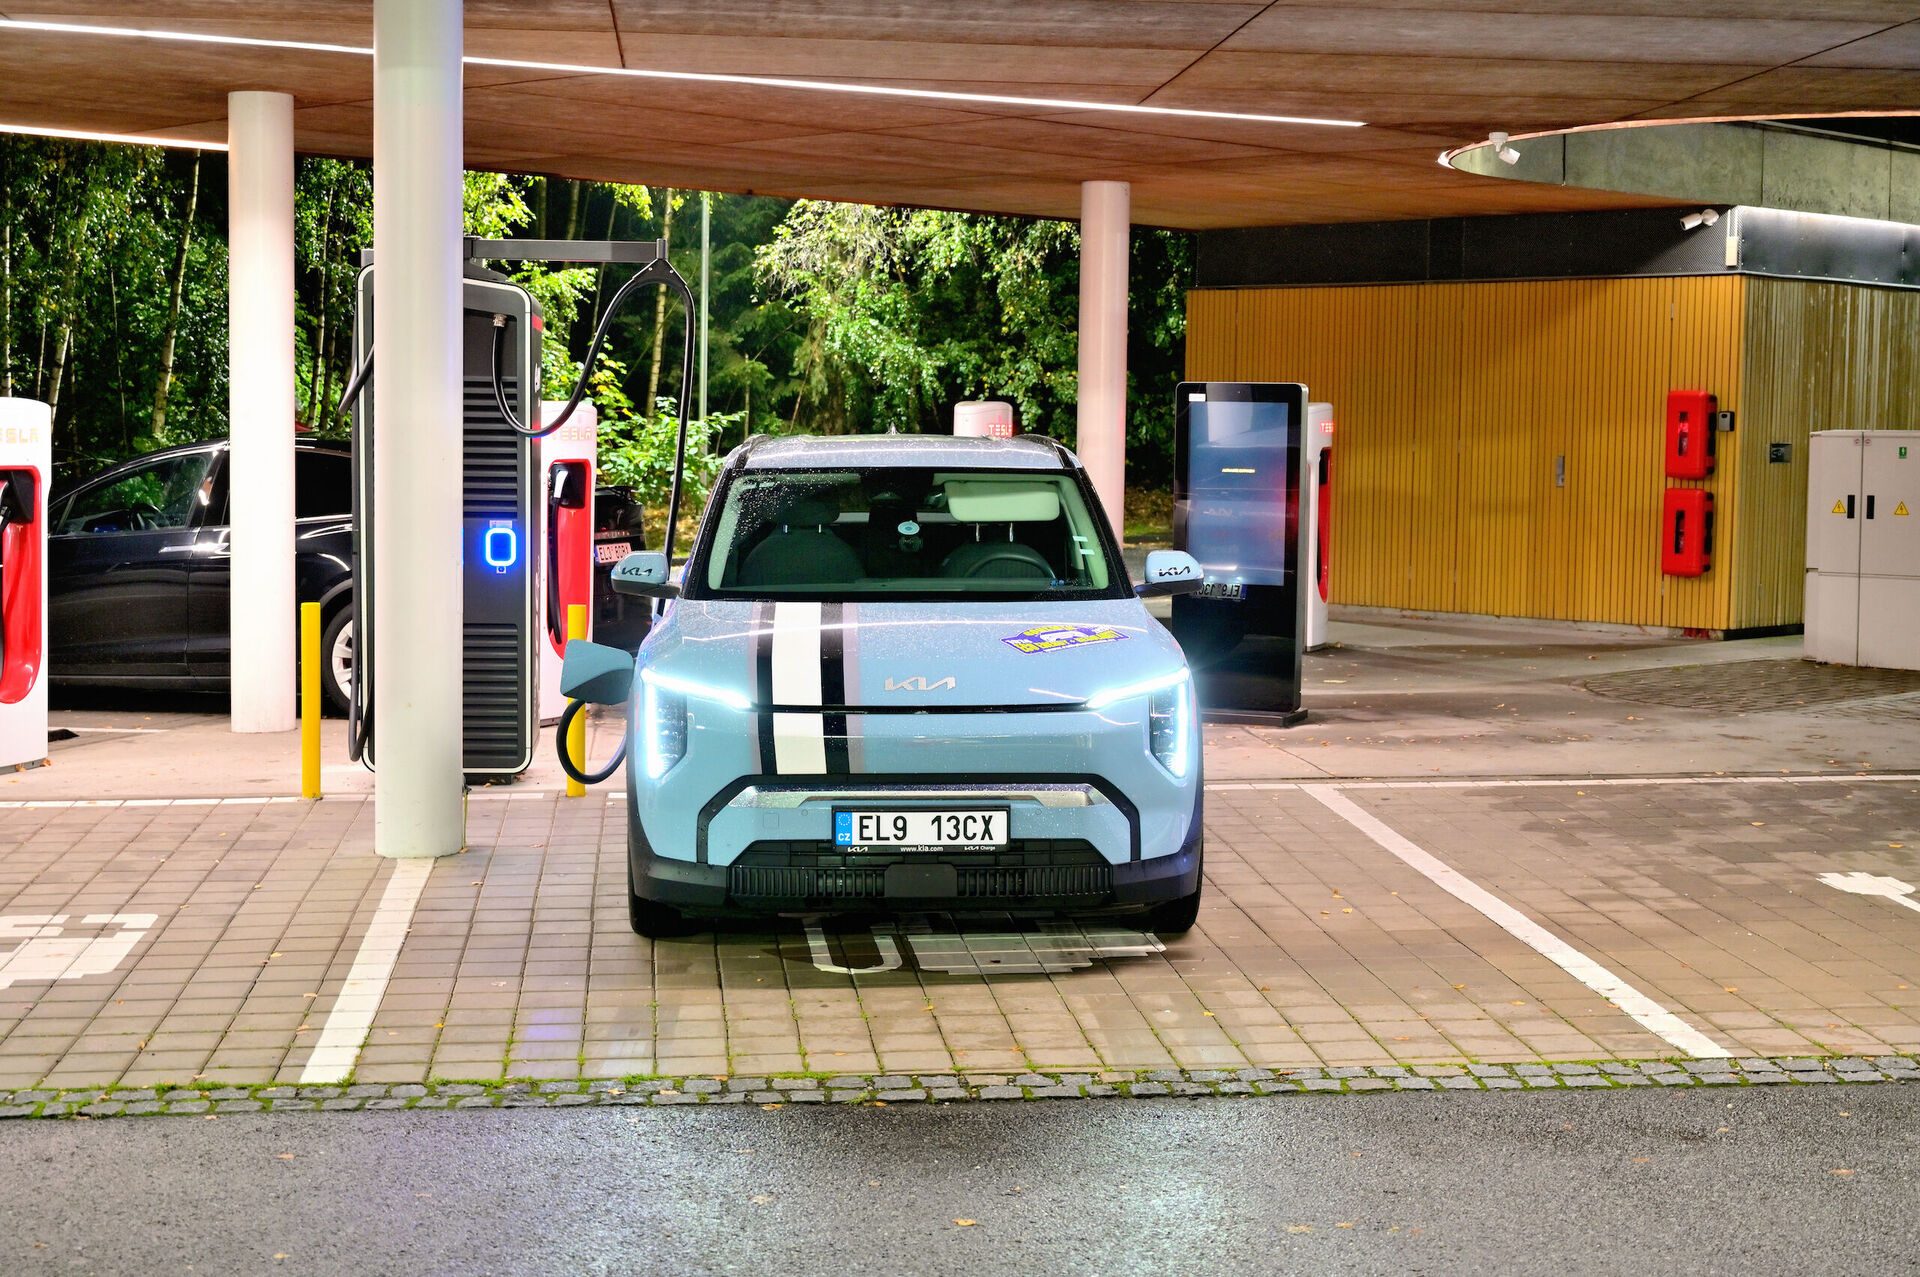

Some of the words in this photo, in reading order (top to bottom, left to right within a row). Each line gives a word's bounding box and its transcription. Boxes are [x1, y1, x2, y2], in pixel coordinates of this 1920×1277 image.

[0, 428, 39, 443] SLA
[621, 566, 653, 577] KIA
[1158, 566, 1191, 577] KIA
[884, 676, 956, 691] KIA
[859, 815, 908, 841] EL9
[931, 815, 994, 841] 13CX
[838, 833, 851, 841] CZ
[900, 844, 944, 852] www.kia.com
